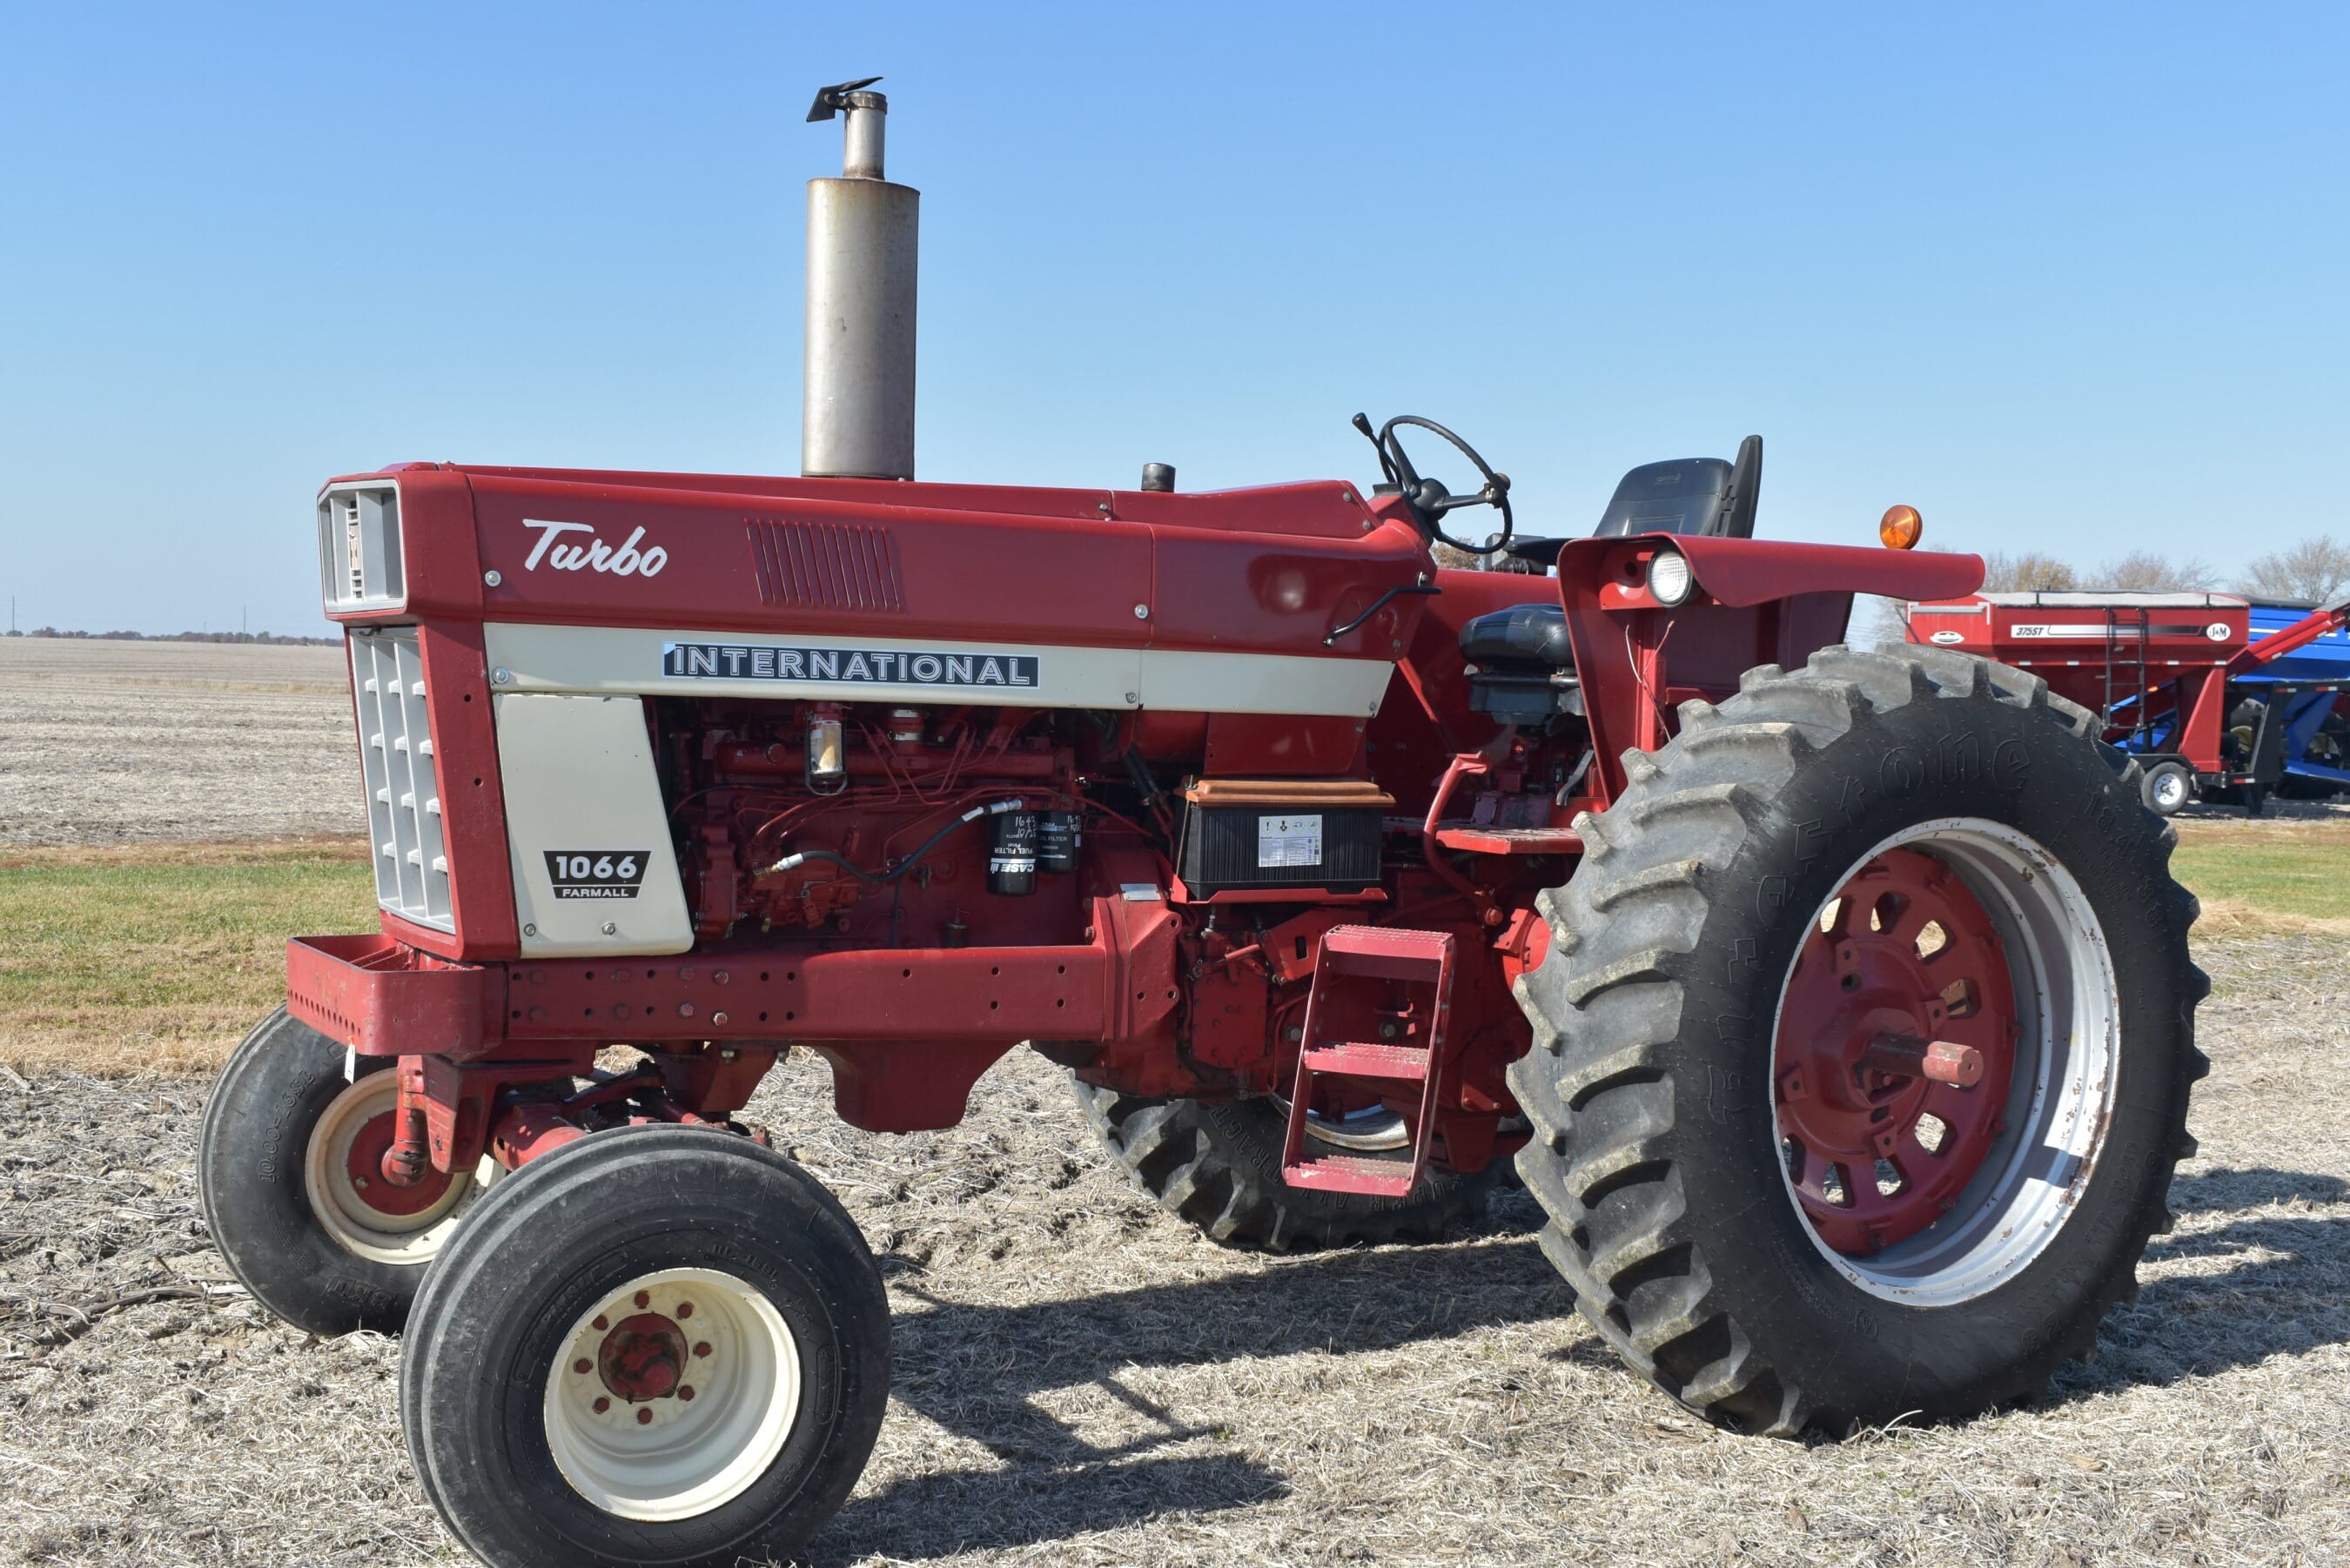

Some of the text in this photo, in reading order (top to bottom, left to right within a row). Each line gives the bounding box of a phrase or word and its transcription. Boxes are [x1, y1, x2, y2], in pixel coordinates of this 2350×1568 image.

[522, 519, 668, 578] Turbo
[2016, 627, 2044, 636] 375ST
[674, 646, 1031, 685] INTERNATIONAL
[556, 856, 637, 879] 1066
[1000, 863, 1034, 873] CASE
[562, 888, 629, 897] FARMALL
